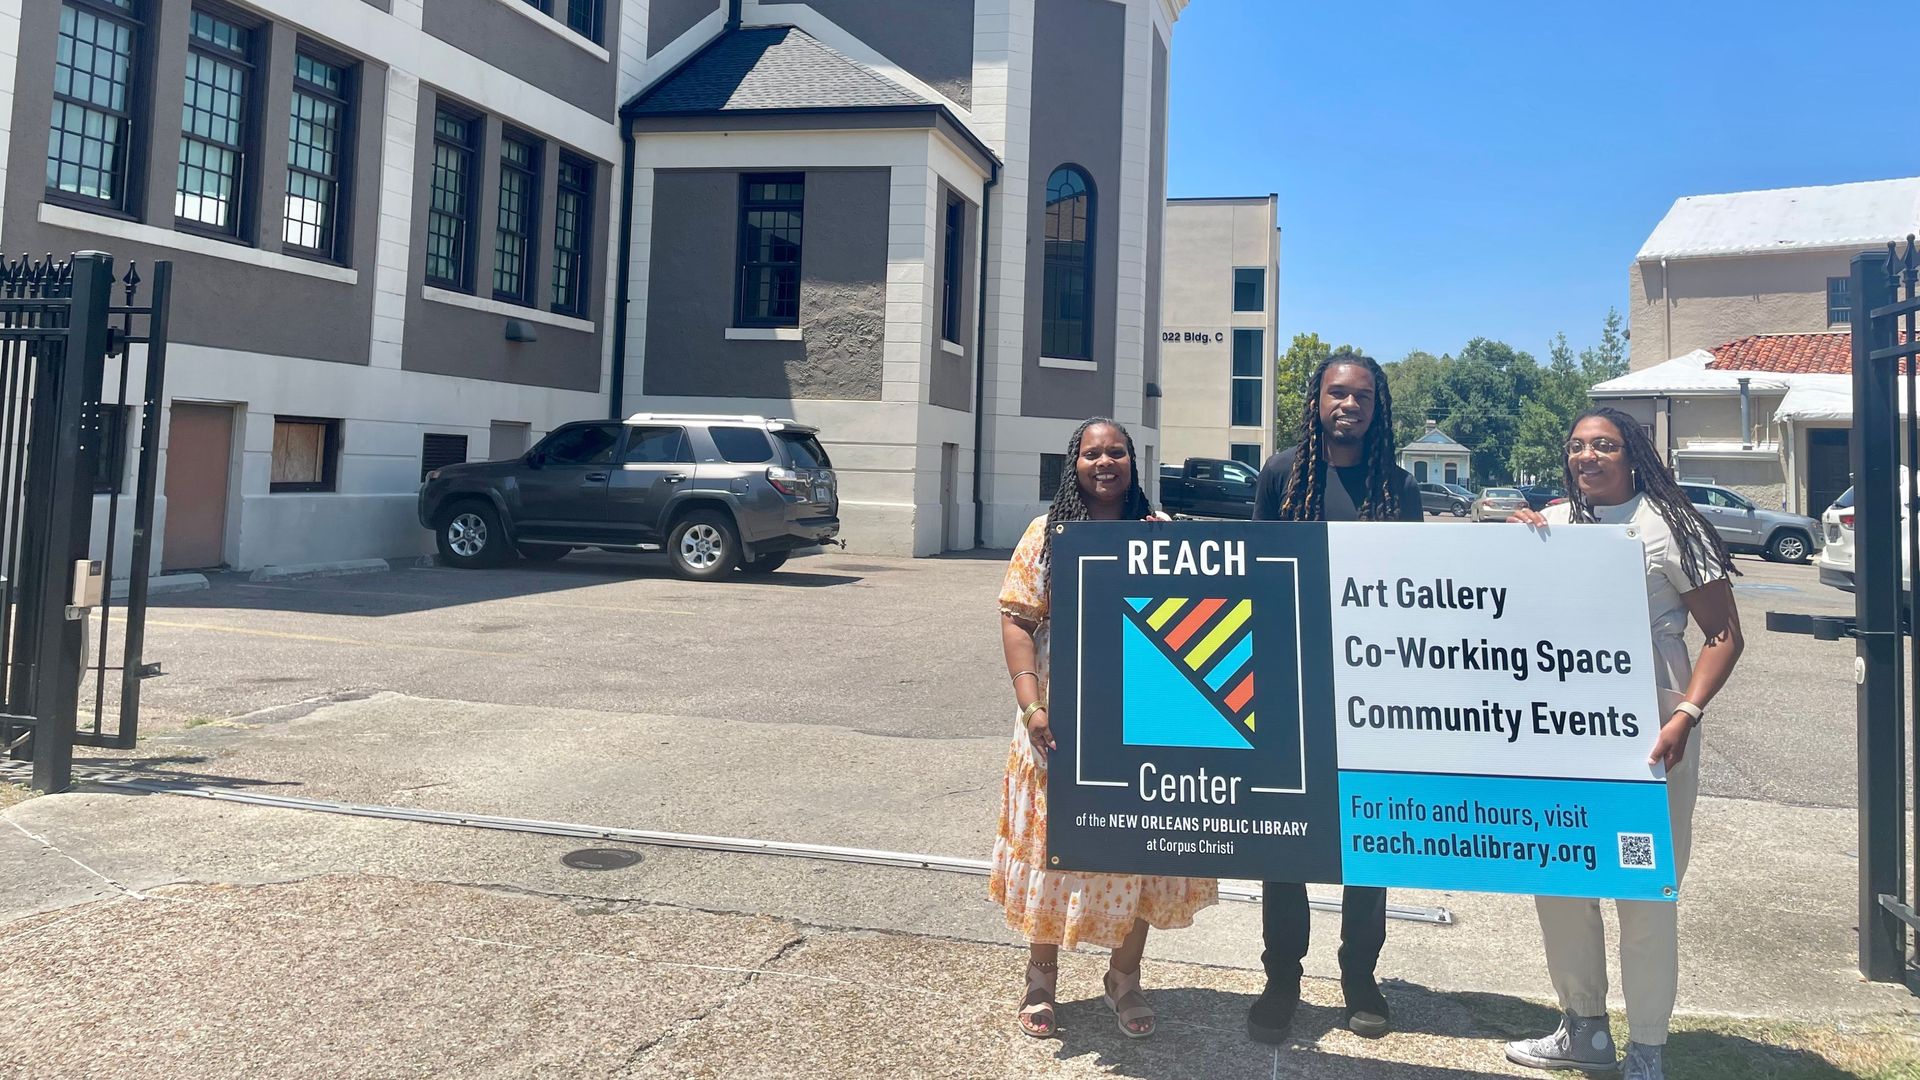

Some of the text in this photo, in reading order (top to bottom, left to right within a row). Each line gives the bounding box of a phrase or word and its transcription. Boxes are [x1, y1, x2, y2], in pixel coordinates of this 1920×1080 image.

[1184, 332, 1212, 344] Bldg.
[1215, 332, 1224, 342] C
[1128, 539, 1246, 576] REACH
[1340, 577, 1507, 620] Art Gallery
[1345, 635, 1631, 682] Co-Working Space
[1347, 695, 1639, 743] Community Events
[1139, 762, 1242, 805] Center
[1075, 812, 1308, 837] of the NEW ORLEANS PUBLIC LIBRARY
[1351, 795, 1589, 833] For info and hours, visit
[1146, 837, 1234, 856] at Corpus Christi
[1352, 830, 1597, 871] reach.nolalibrary.org
